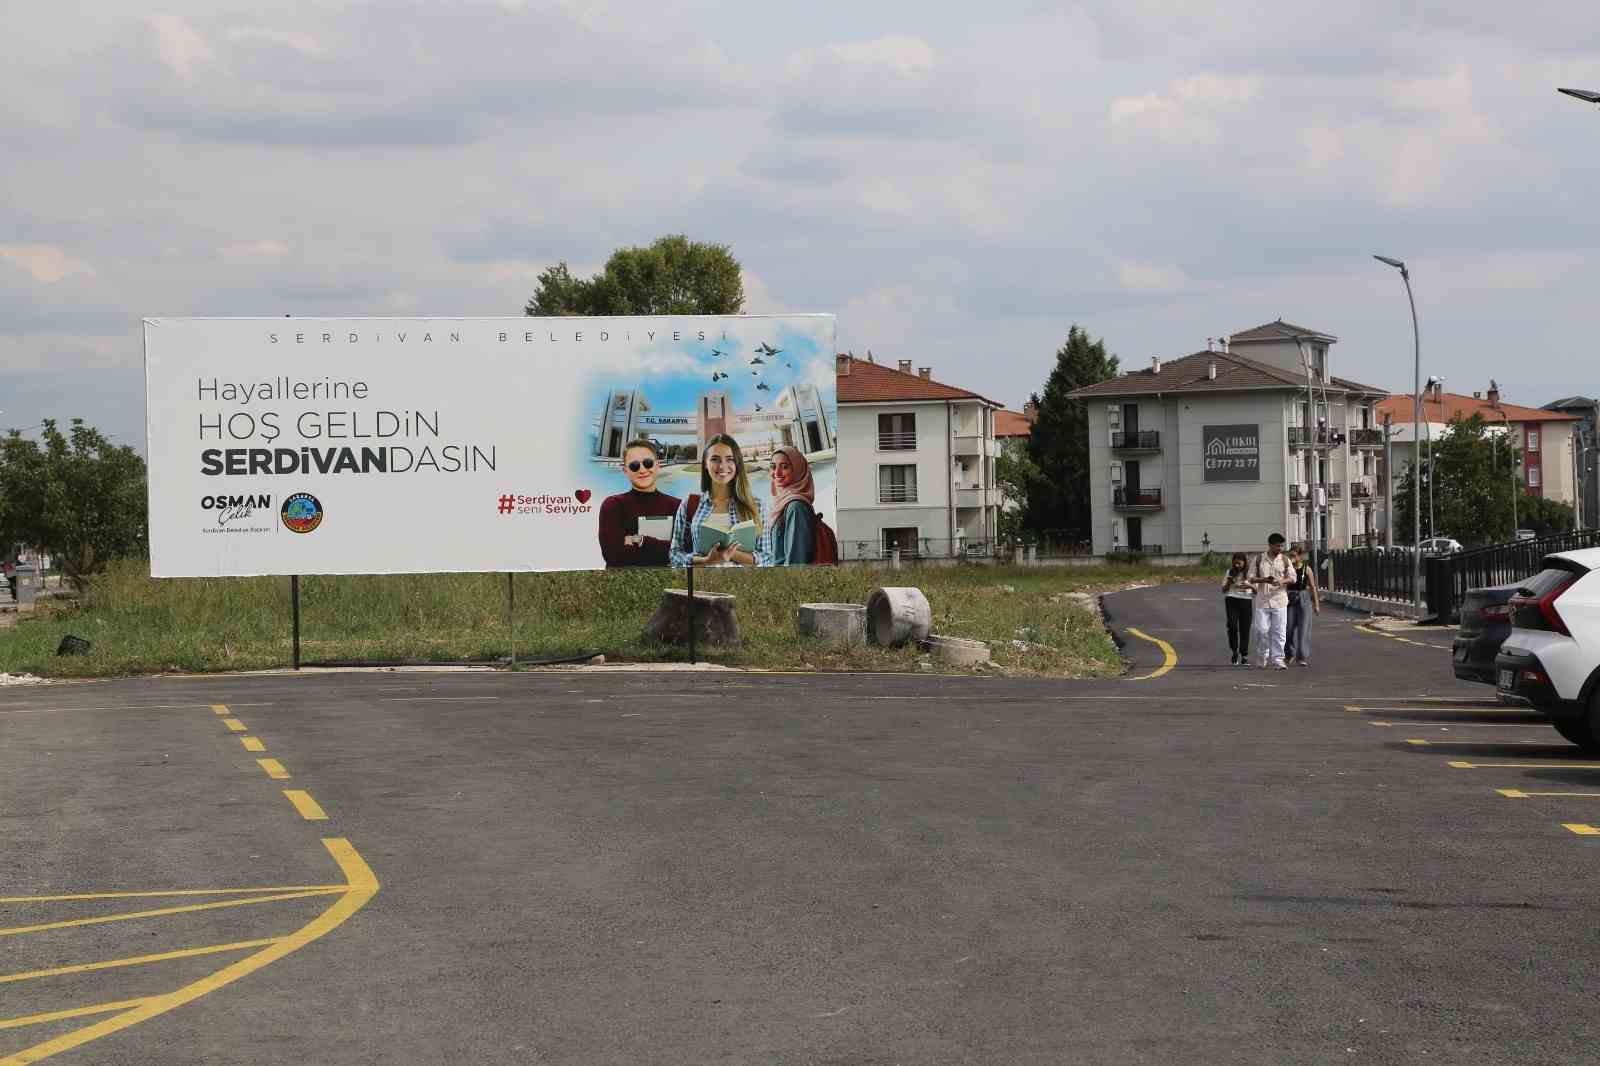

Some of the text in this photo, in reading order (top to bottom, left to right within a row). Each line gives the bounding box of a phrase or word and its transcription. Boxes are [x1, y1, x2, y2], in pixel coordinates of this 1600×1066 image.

[198, 376, 369, 405] Hayallerine
[199, 411, 281, 444] HOŞ
[201, 494, 271, 510] OSMAN
[517, 504, 592, 515] seni Seviyor
